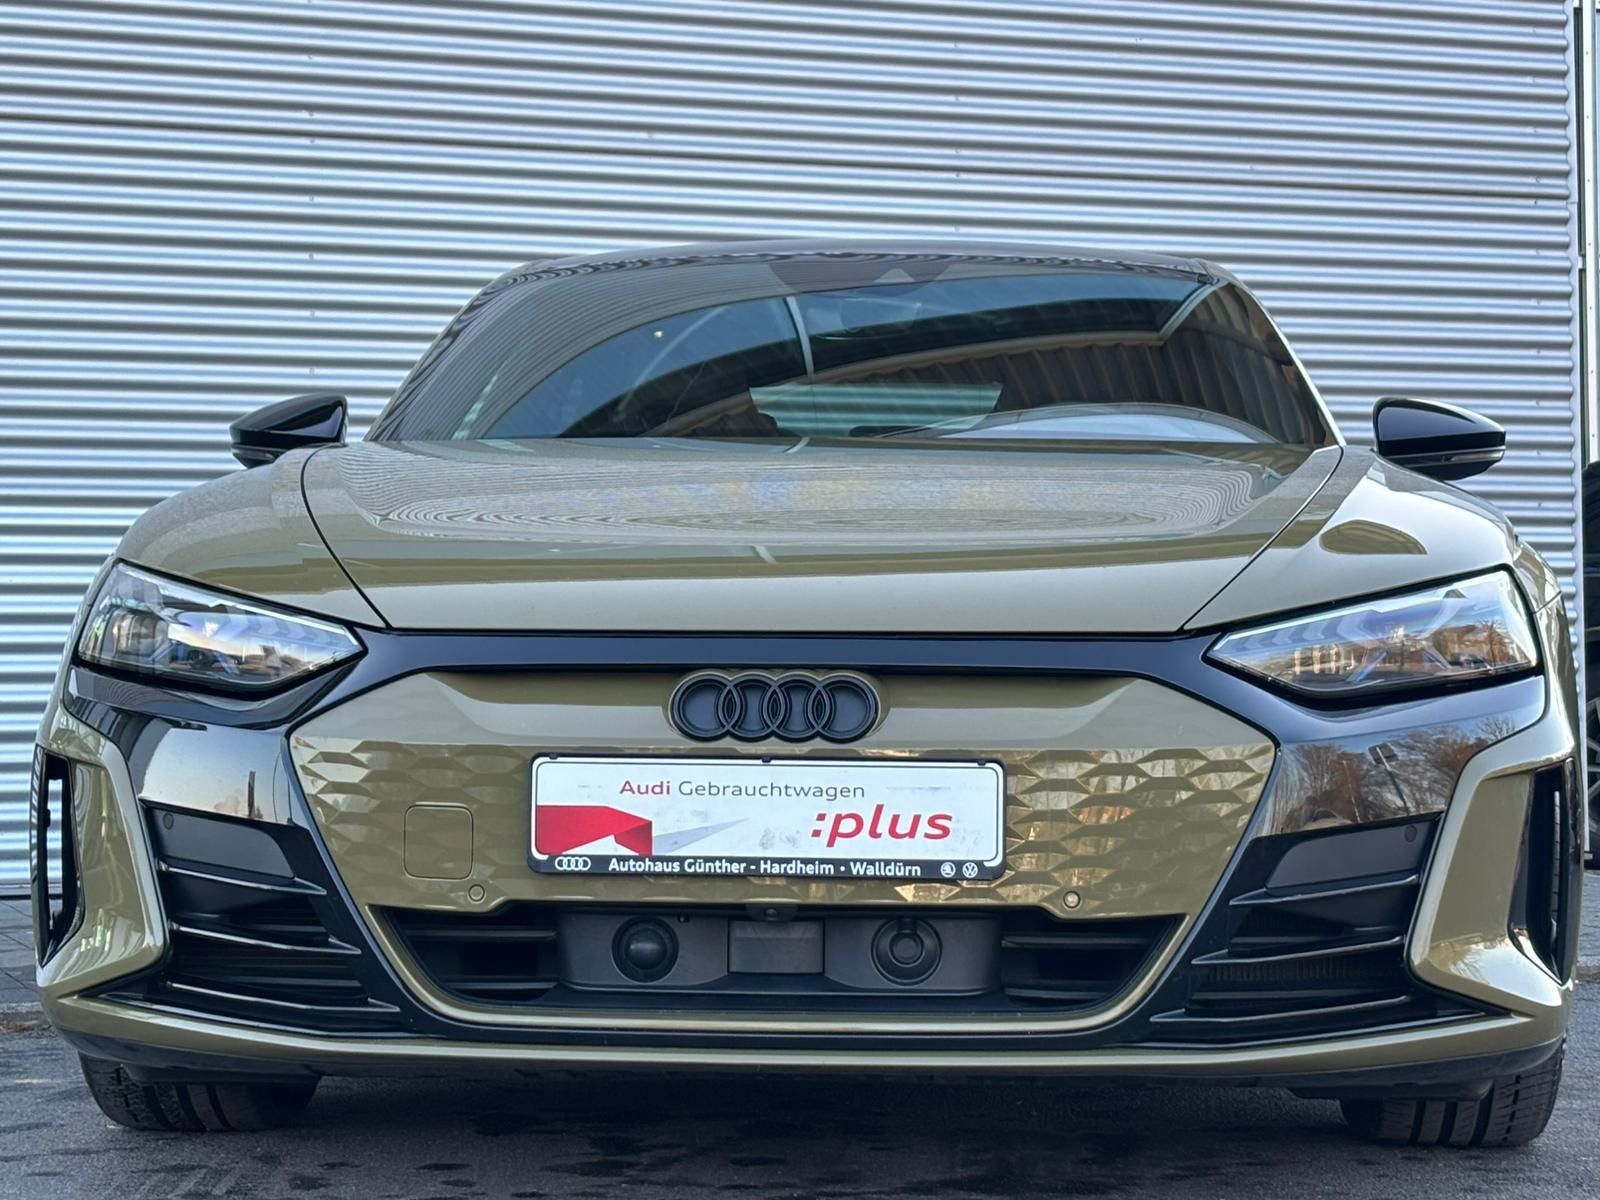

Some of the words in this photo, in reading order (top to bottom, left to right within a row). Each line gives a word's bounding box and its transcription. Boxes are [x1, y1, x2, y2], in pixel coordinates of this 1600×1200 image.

[619, 780, 671, 796] Audi
[678, 781, 865, 801] Gebrauchtwagen
[811, 804, 953, 847] :plus
[608, 858, 680, 873] Autohaus
[684, 858, 747, 874] Günther
[760, 860, 834, 875] Hardheim
[850, 861, 921, 877] Walldürn
